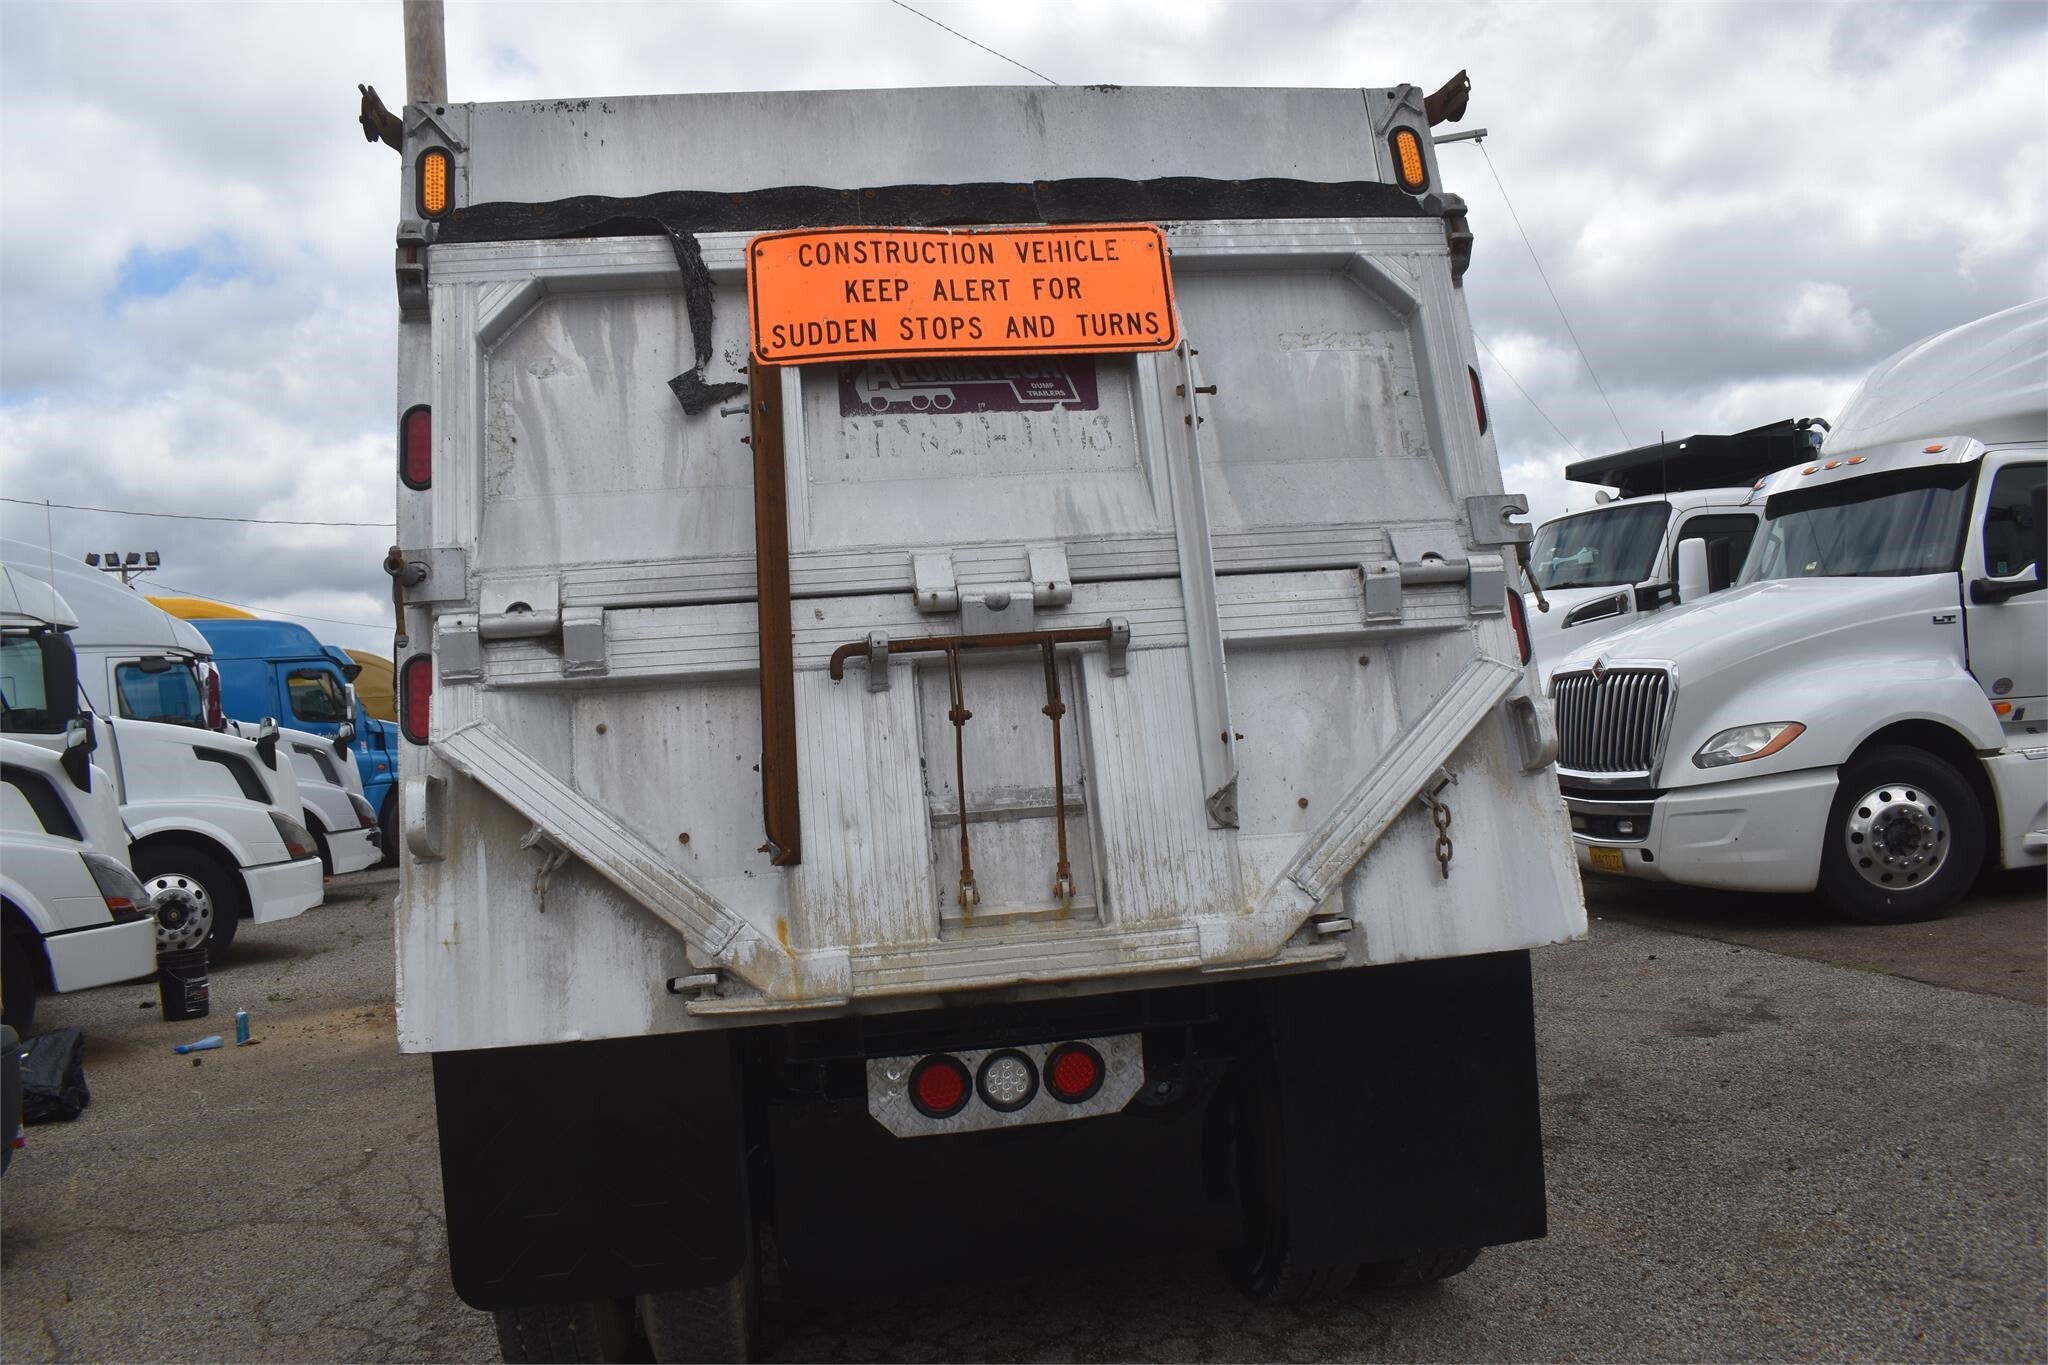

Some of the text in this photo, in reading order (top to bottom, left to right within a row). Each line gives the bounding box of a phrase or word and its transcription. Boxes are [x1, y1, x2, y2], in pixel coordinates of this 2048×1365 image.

[798, 239, 1120, 267] CONSTRUCTION VEHICLE
[845, 277, 1082, 303] KEEP ALERT FOR
[771, 311, 1159, 349] SUDDEN STOPS AND TURNS
